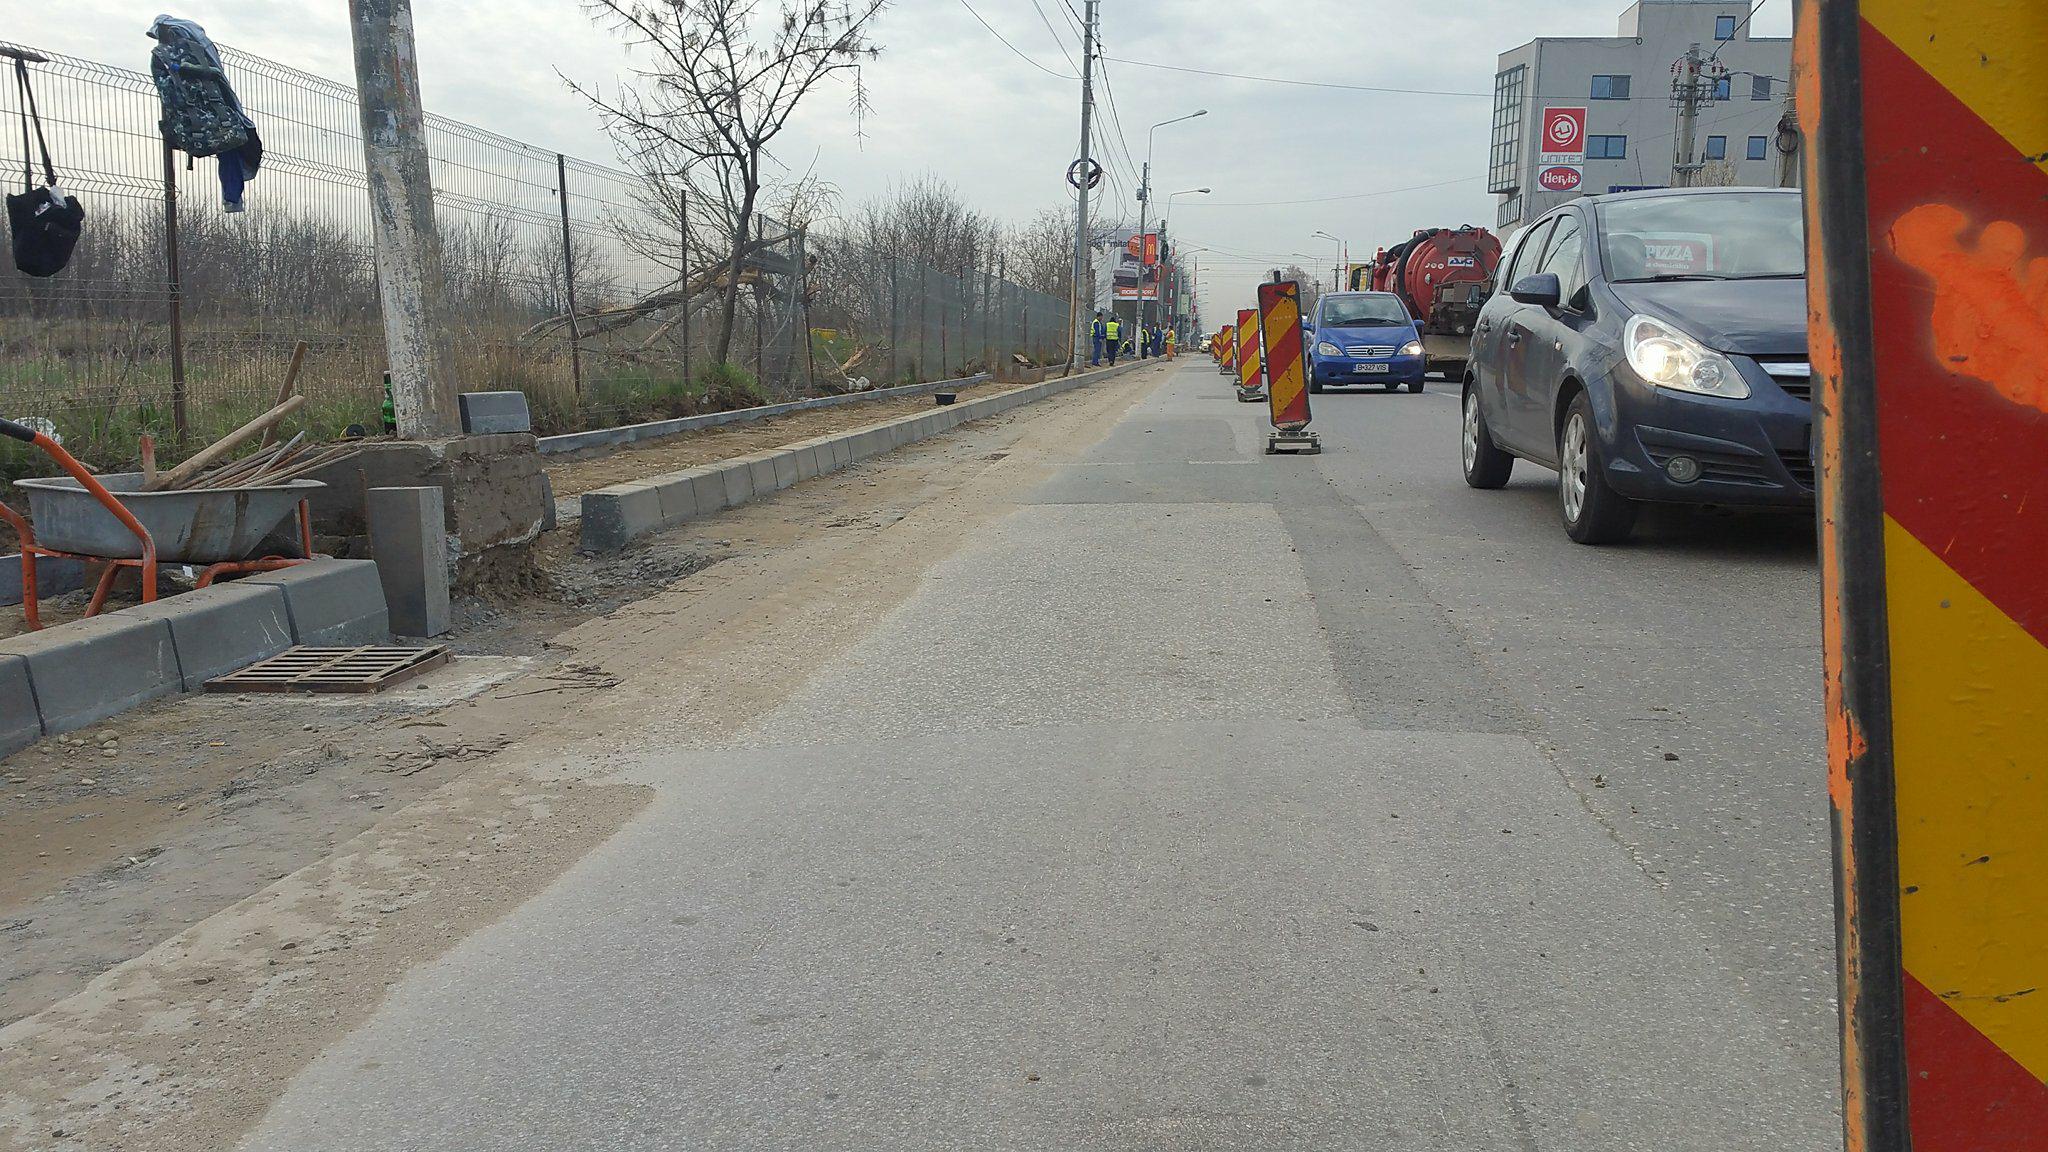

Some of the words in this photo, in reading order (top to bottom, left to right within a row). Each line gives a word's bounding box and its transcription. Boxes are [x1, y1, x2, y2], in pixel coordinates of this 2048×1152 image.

[1541, 154, 1582, 163] UNITED
[1543, 172, 1578, 186] Hervis
[1645, 245, 1694, 261] PIZZA
